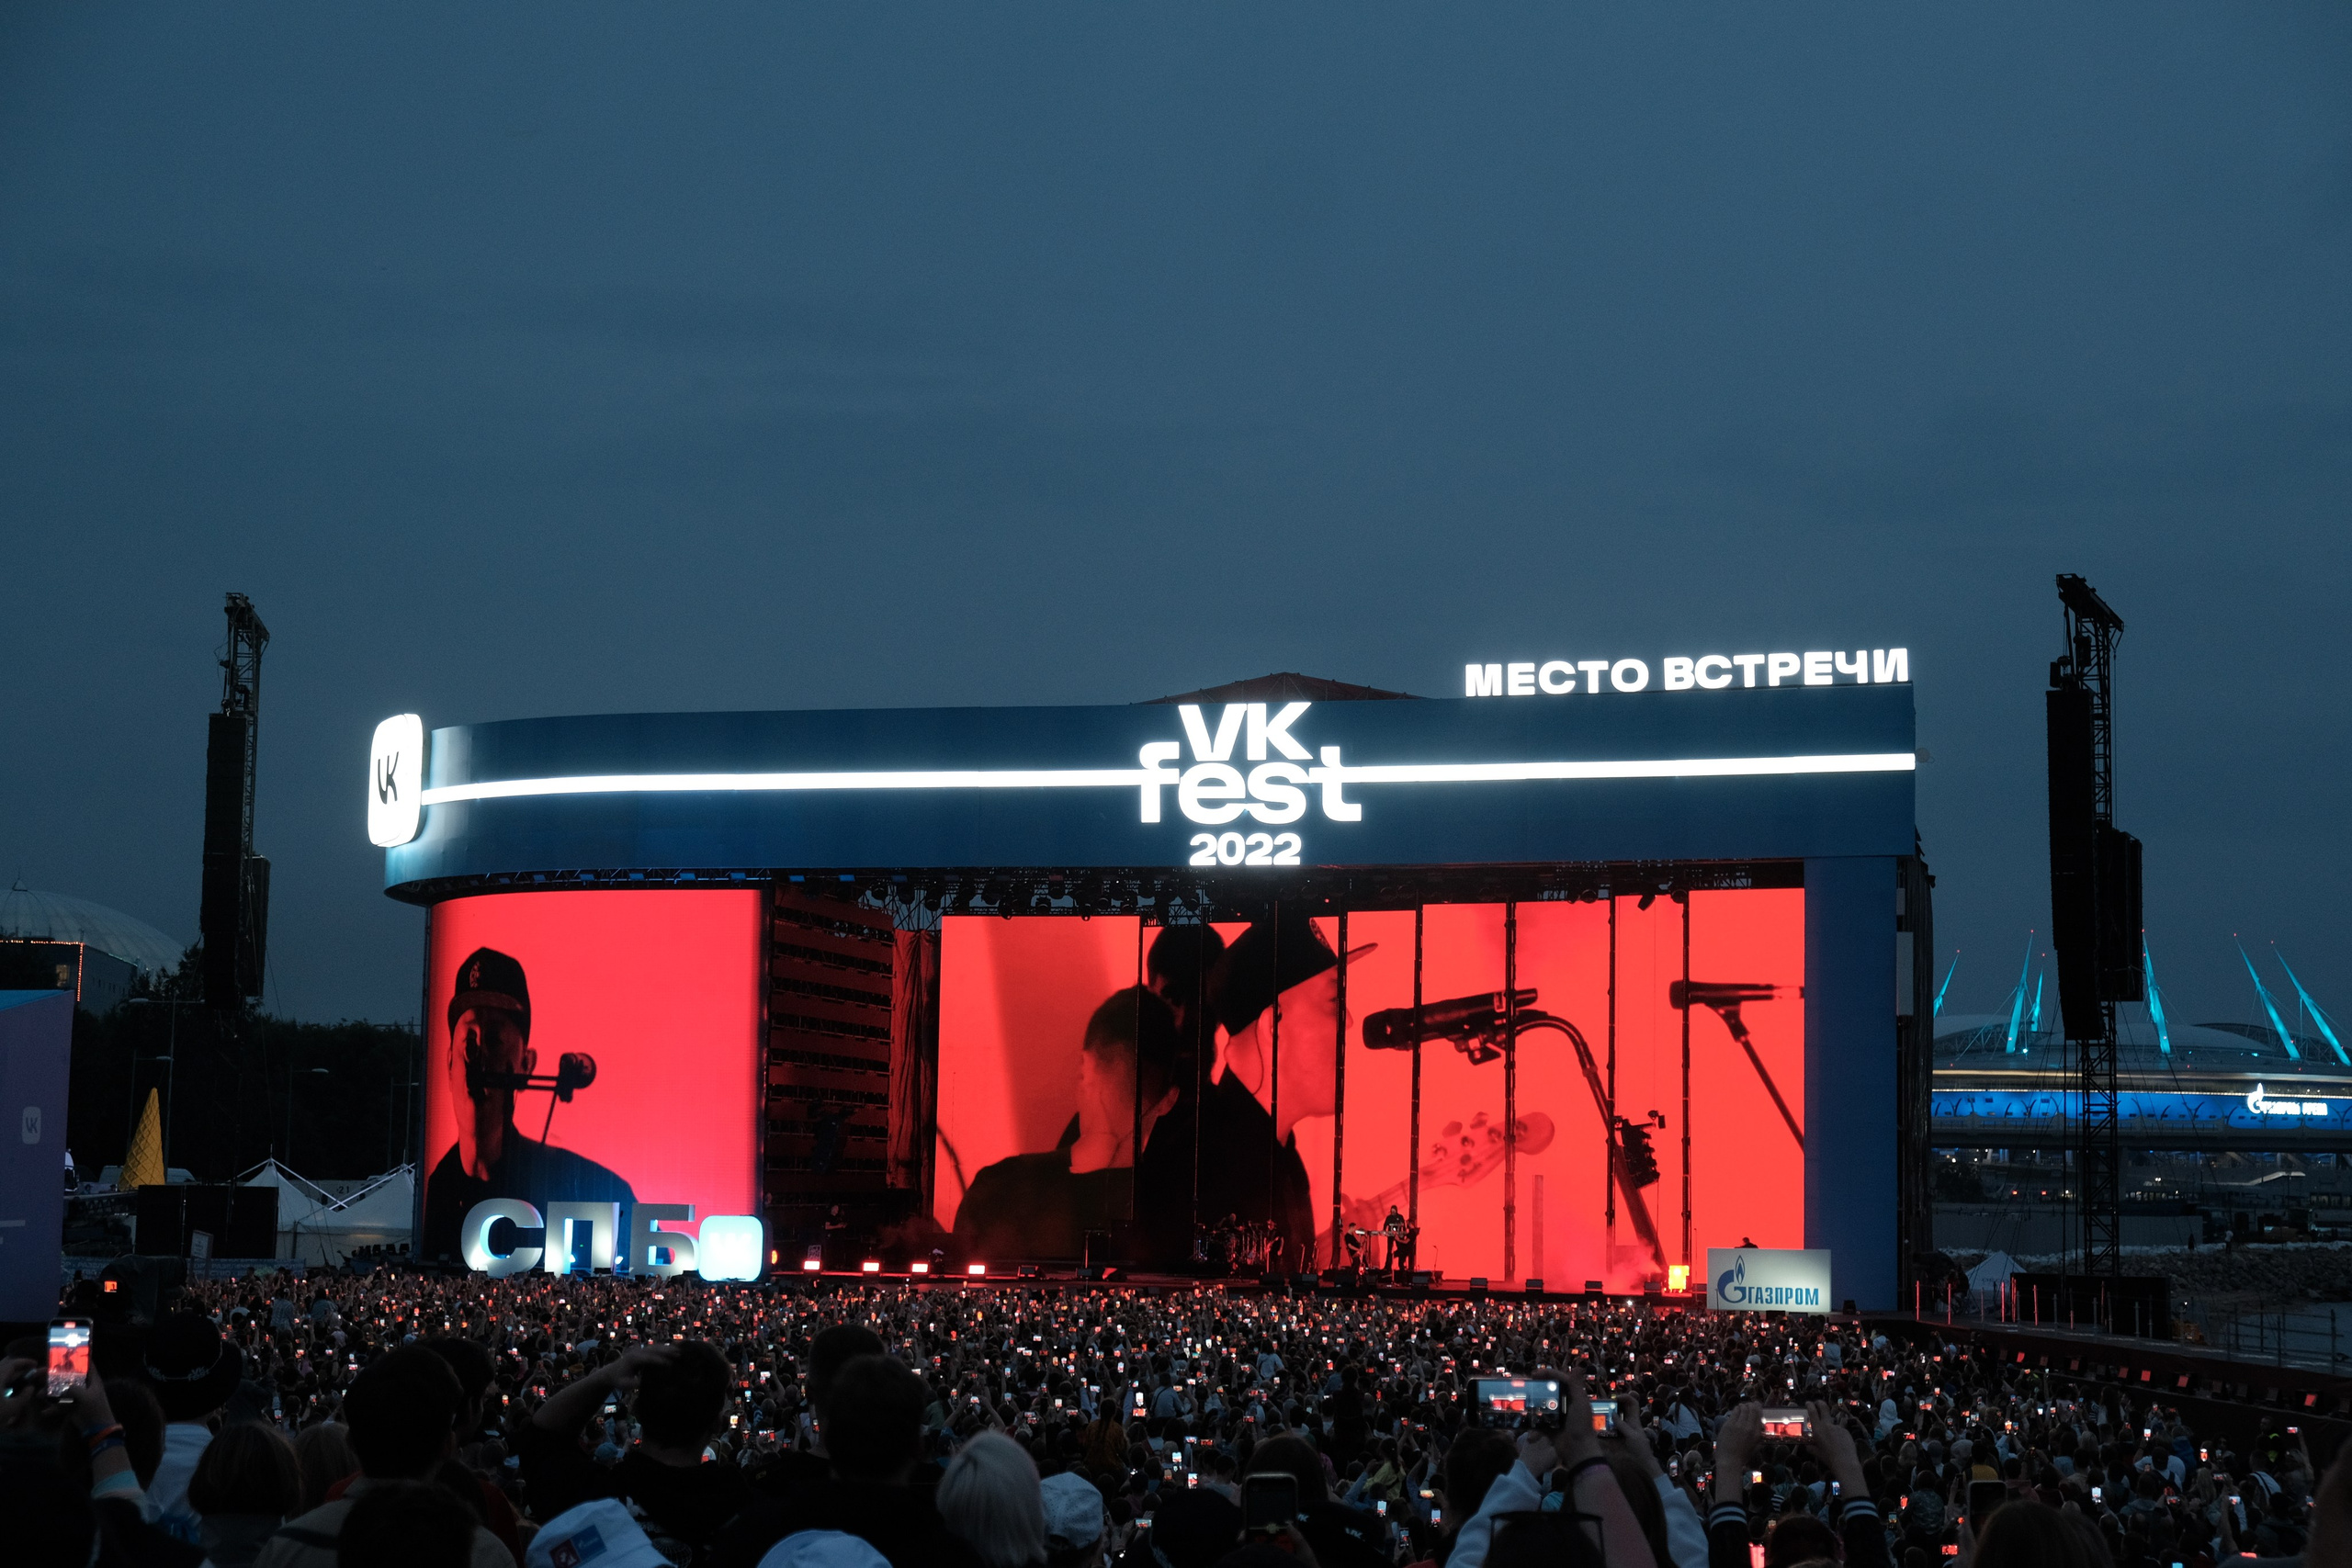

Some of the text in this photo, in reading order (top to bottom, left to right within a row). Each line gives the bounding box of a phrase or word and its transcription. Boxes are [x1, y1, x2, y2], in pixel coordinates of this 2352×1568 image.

[1464, 648, 1909, 697] МЕСТО ВСТРЕЧИ
[1179, 702, 1313, 761] VK
[1139, 741, 1363, 825] fest
[1189, 831, 1302, 866] 2022
[461, 1198, 700, 1280] СПБ
[1747, 1286, 1819, 1305] ГАЗПРОМ
